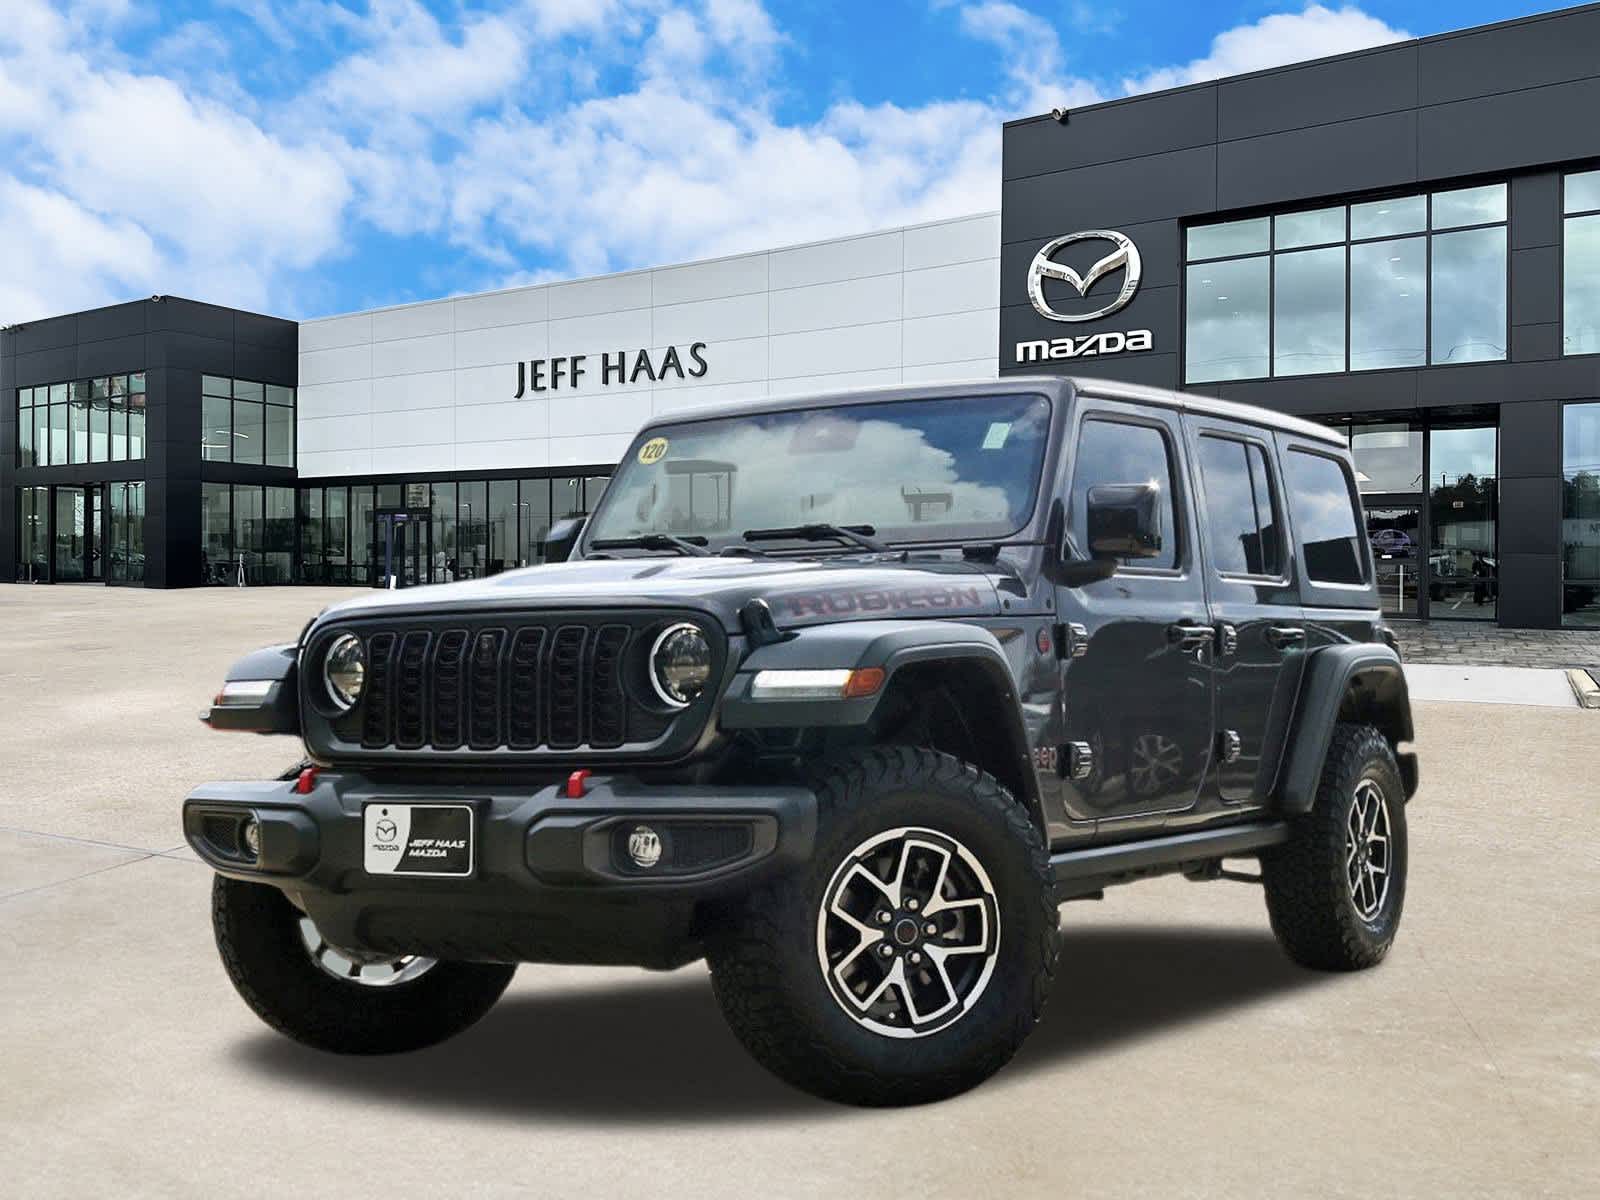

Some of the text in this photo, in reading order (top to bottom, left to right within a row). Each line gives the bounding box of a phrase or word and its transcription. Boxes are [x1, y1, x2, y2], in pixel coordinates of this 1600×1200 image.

[1015, 329, 1153, 362] mazda
[514, 342, 708, 399] JEFF HAAS
[642, 443, 665, 459] 120
[792, 587, 981, 617] RUBICON
[408, 849, 448, 857] MAZDA
[409, 840, 467, 848] JEFF HAAS
